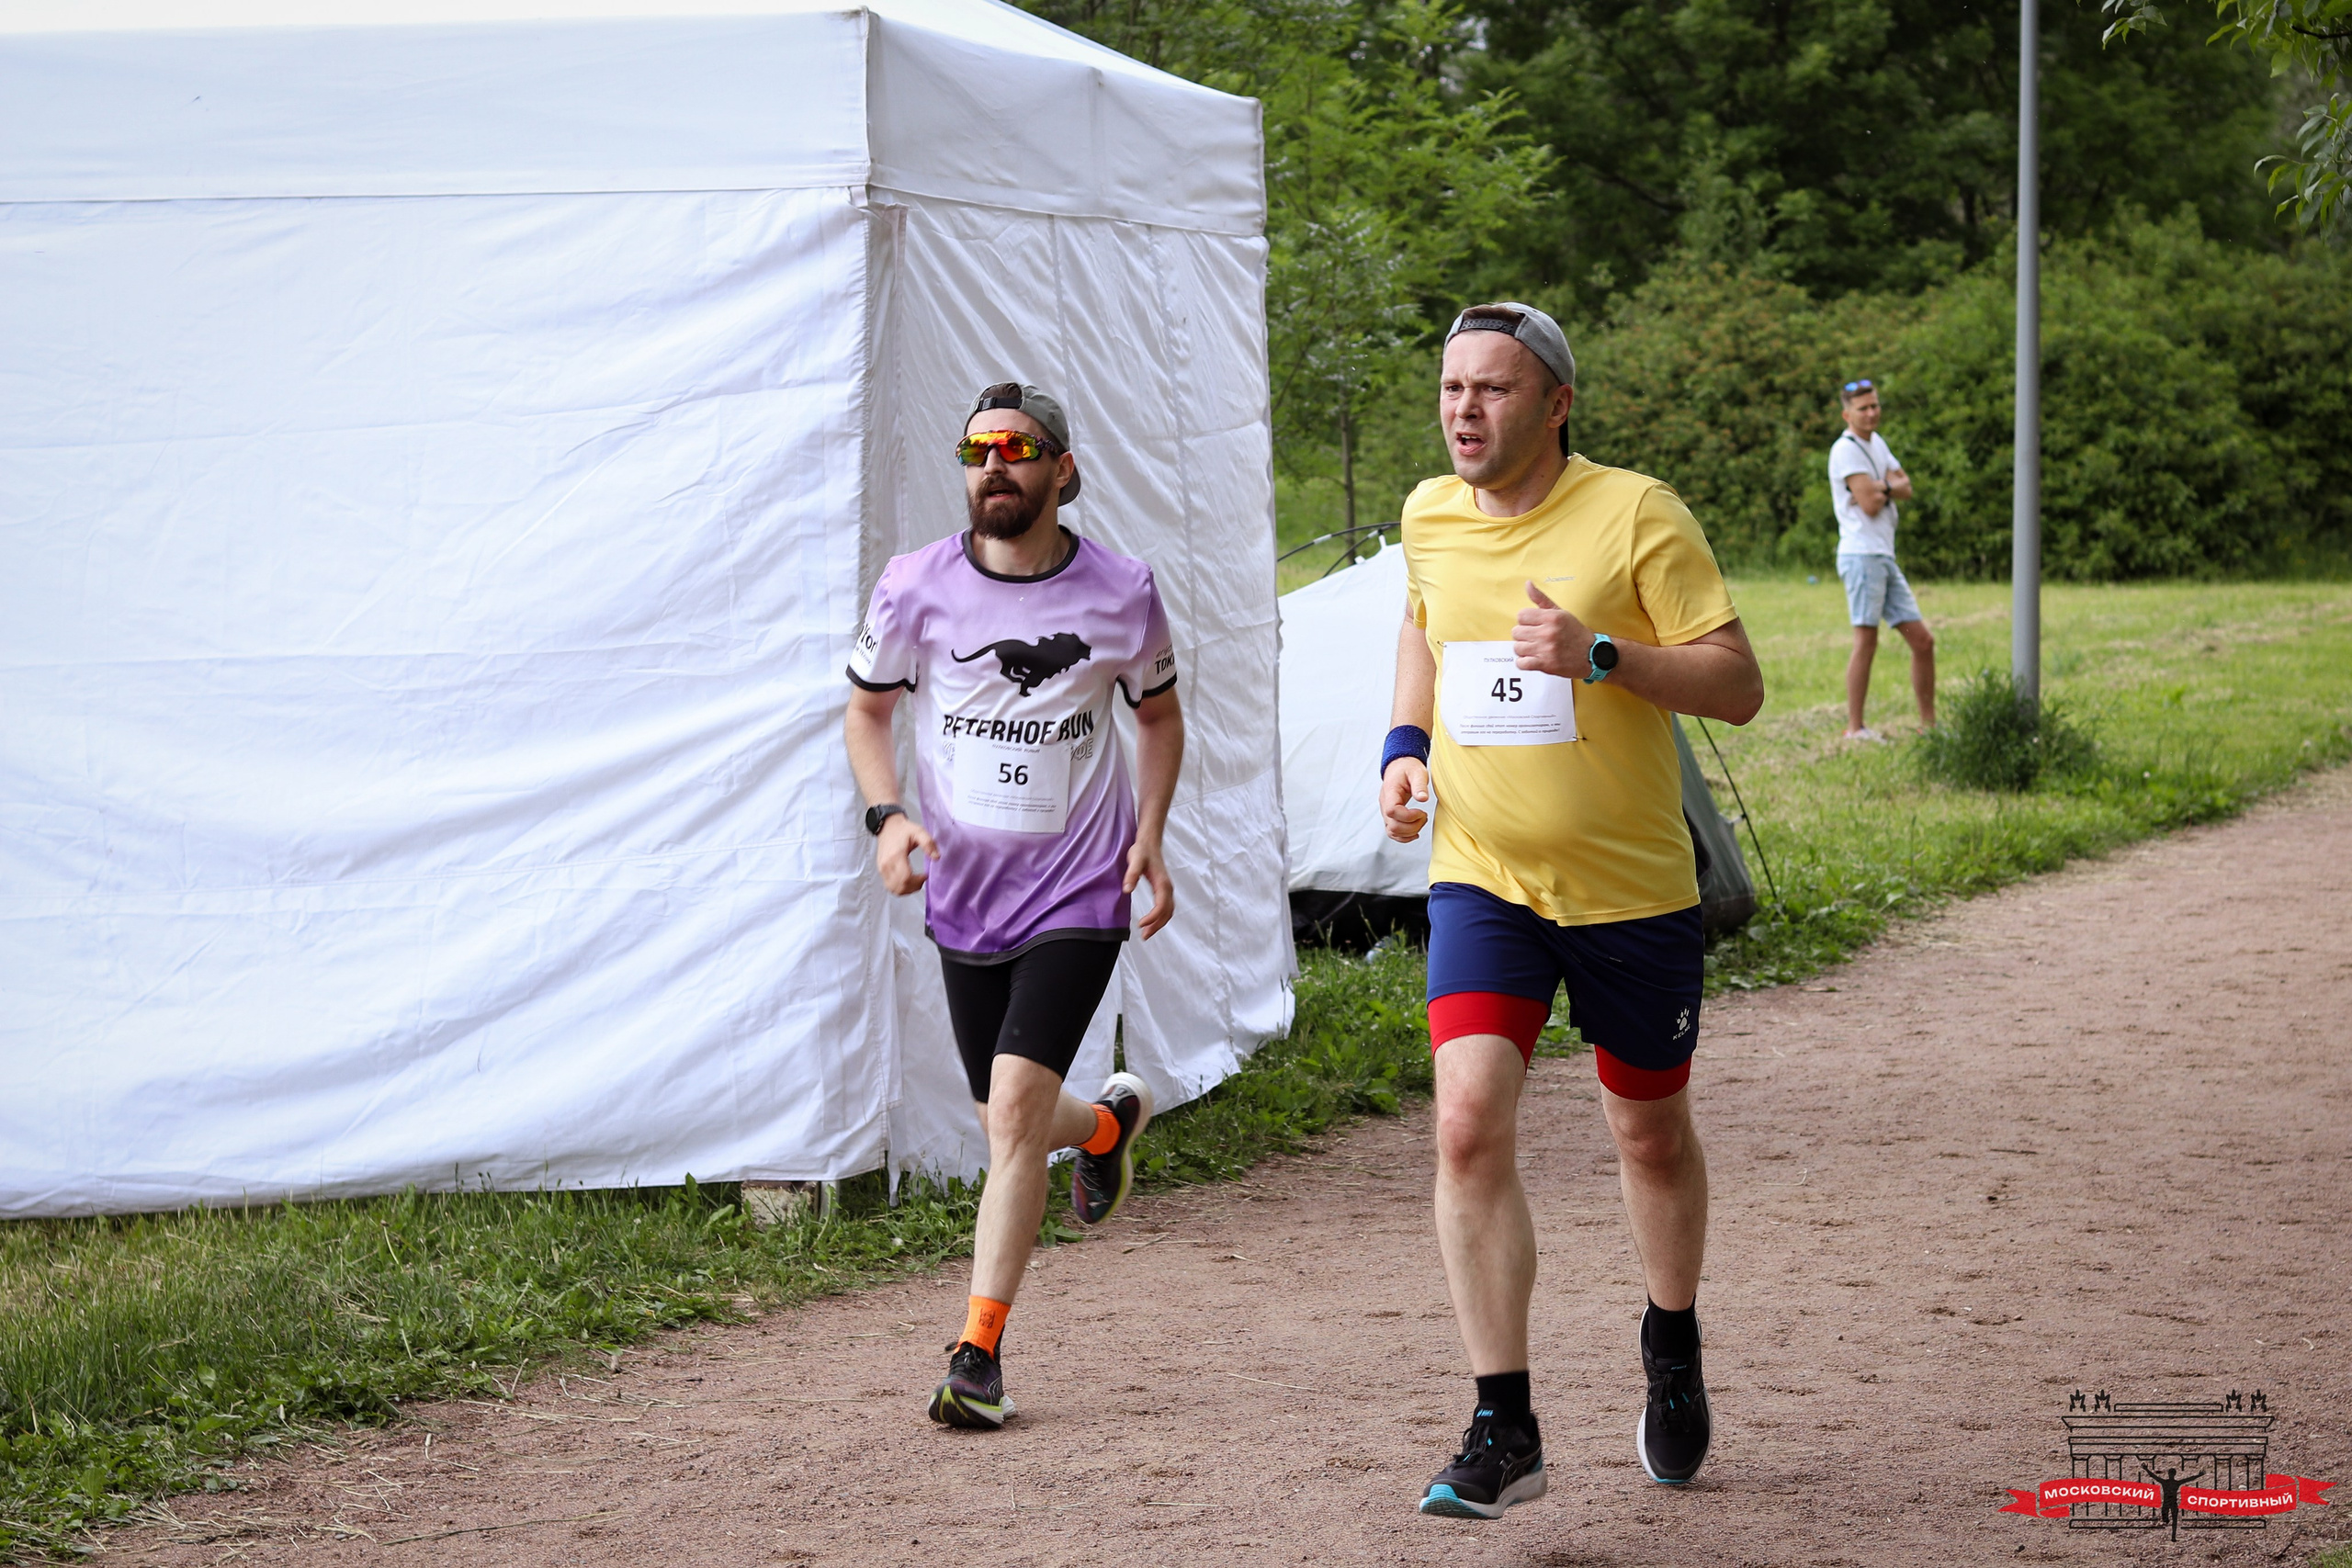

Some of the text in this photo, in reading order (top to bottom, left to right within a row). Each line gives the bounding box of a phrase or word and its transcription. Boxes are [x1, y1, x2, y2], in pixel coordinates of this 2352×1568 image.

[1491, 677, 1523, 703] 45
[943, 709, 1094, 745] PETERHOF RUN
[998, 762, 1029, 785] 56
